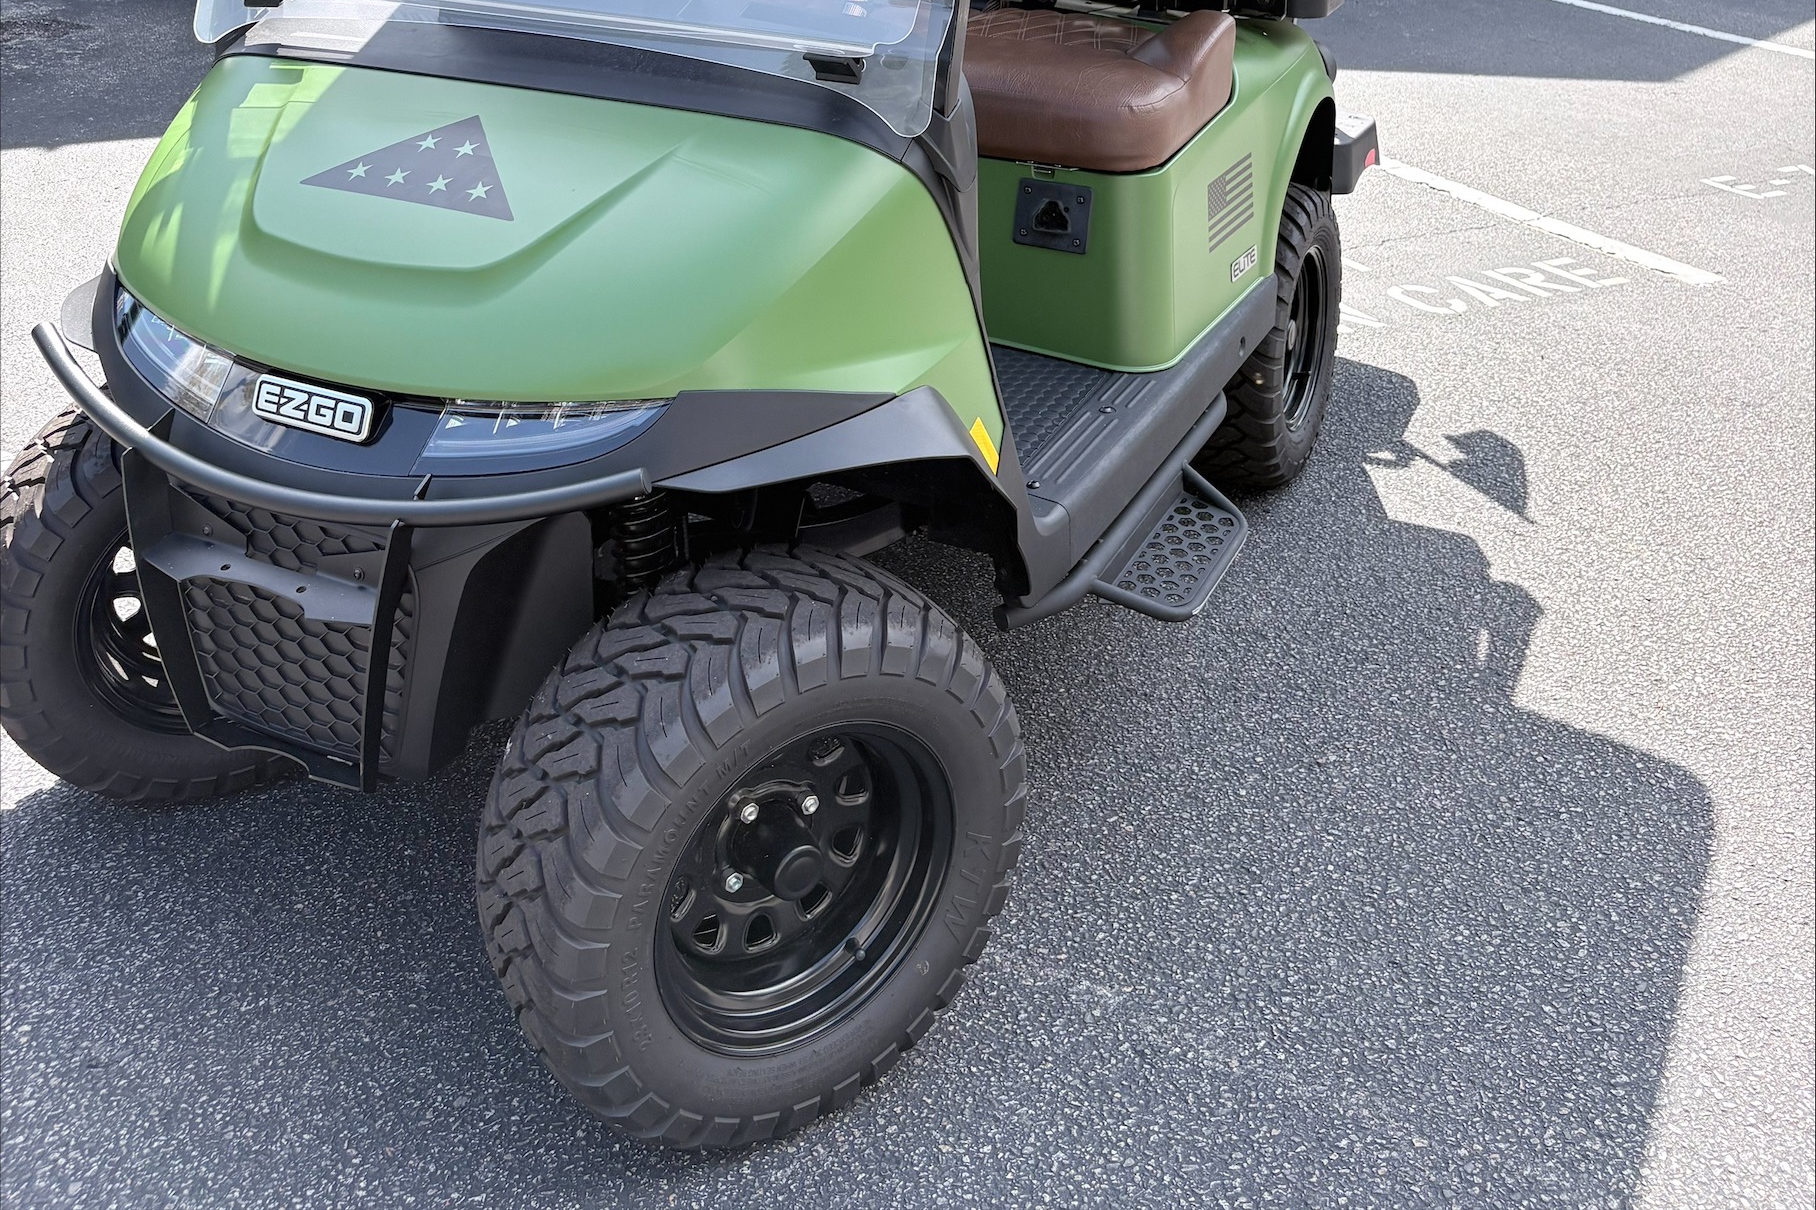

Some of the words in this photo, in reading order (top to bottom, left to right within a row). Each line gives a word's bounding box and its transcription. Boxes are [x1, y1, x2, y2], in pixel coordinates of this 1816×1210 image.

[1387, 257, 1630, 315] CARE
[257, 382, 363, 433] EZGO
[627, 779, 709, 931] PARAMOUNT
[715, 738, 751, 779] M/T
